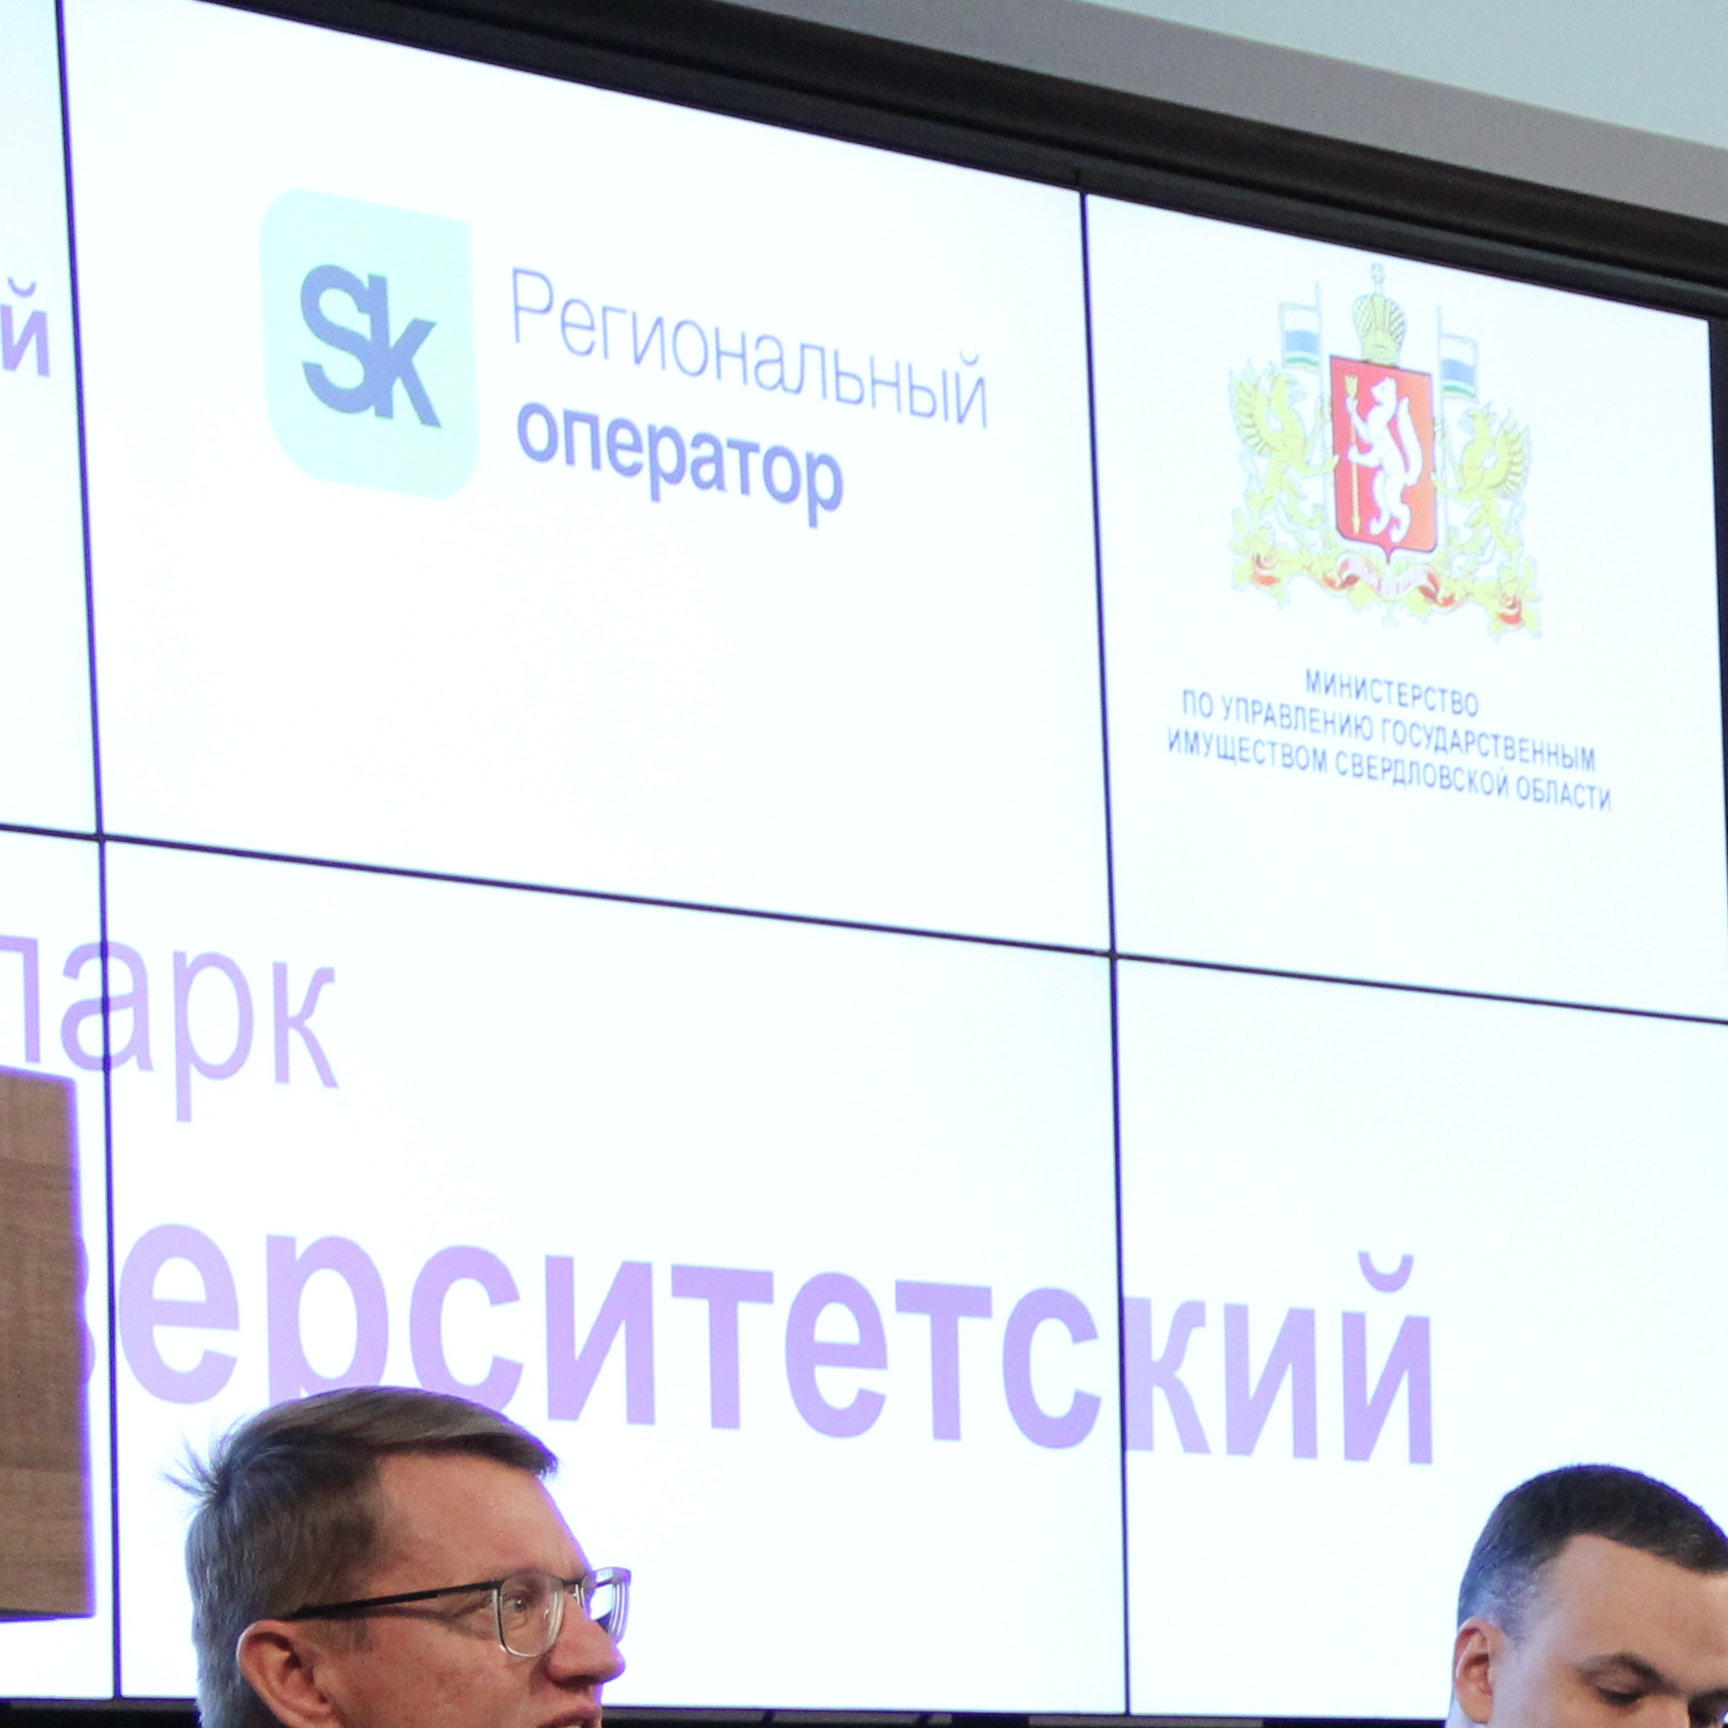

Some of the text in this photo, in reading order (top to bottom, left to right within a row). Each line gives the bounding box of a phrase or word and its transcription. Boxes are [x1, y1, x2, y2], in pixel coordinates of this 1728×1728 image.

[299, 264, 443, 430] Sk
[511, 266, 988, 430] Региональный
[516, 401, 845, 530] оператор
[1181, 688, 1597, 773] ПО УПРАВЛЕНИЮ ГОСУДАРСТВЕННЫМ
[1305, 667, 1480, 719] МИНИСТЕРСТВО
[1167, 726, 1612, 813] ИМУЩЕСТВОМ СВЕРДЛОВСКОЙ ОБЛАСТИ
[78, 1222, 1435, 1466] ерситетский
